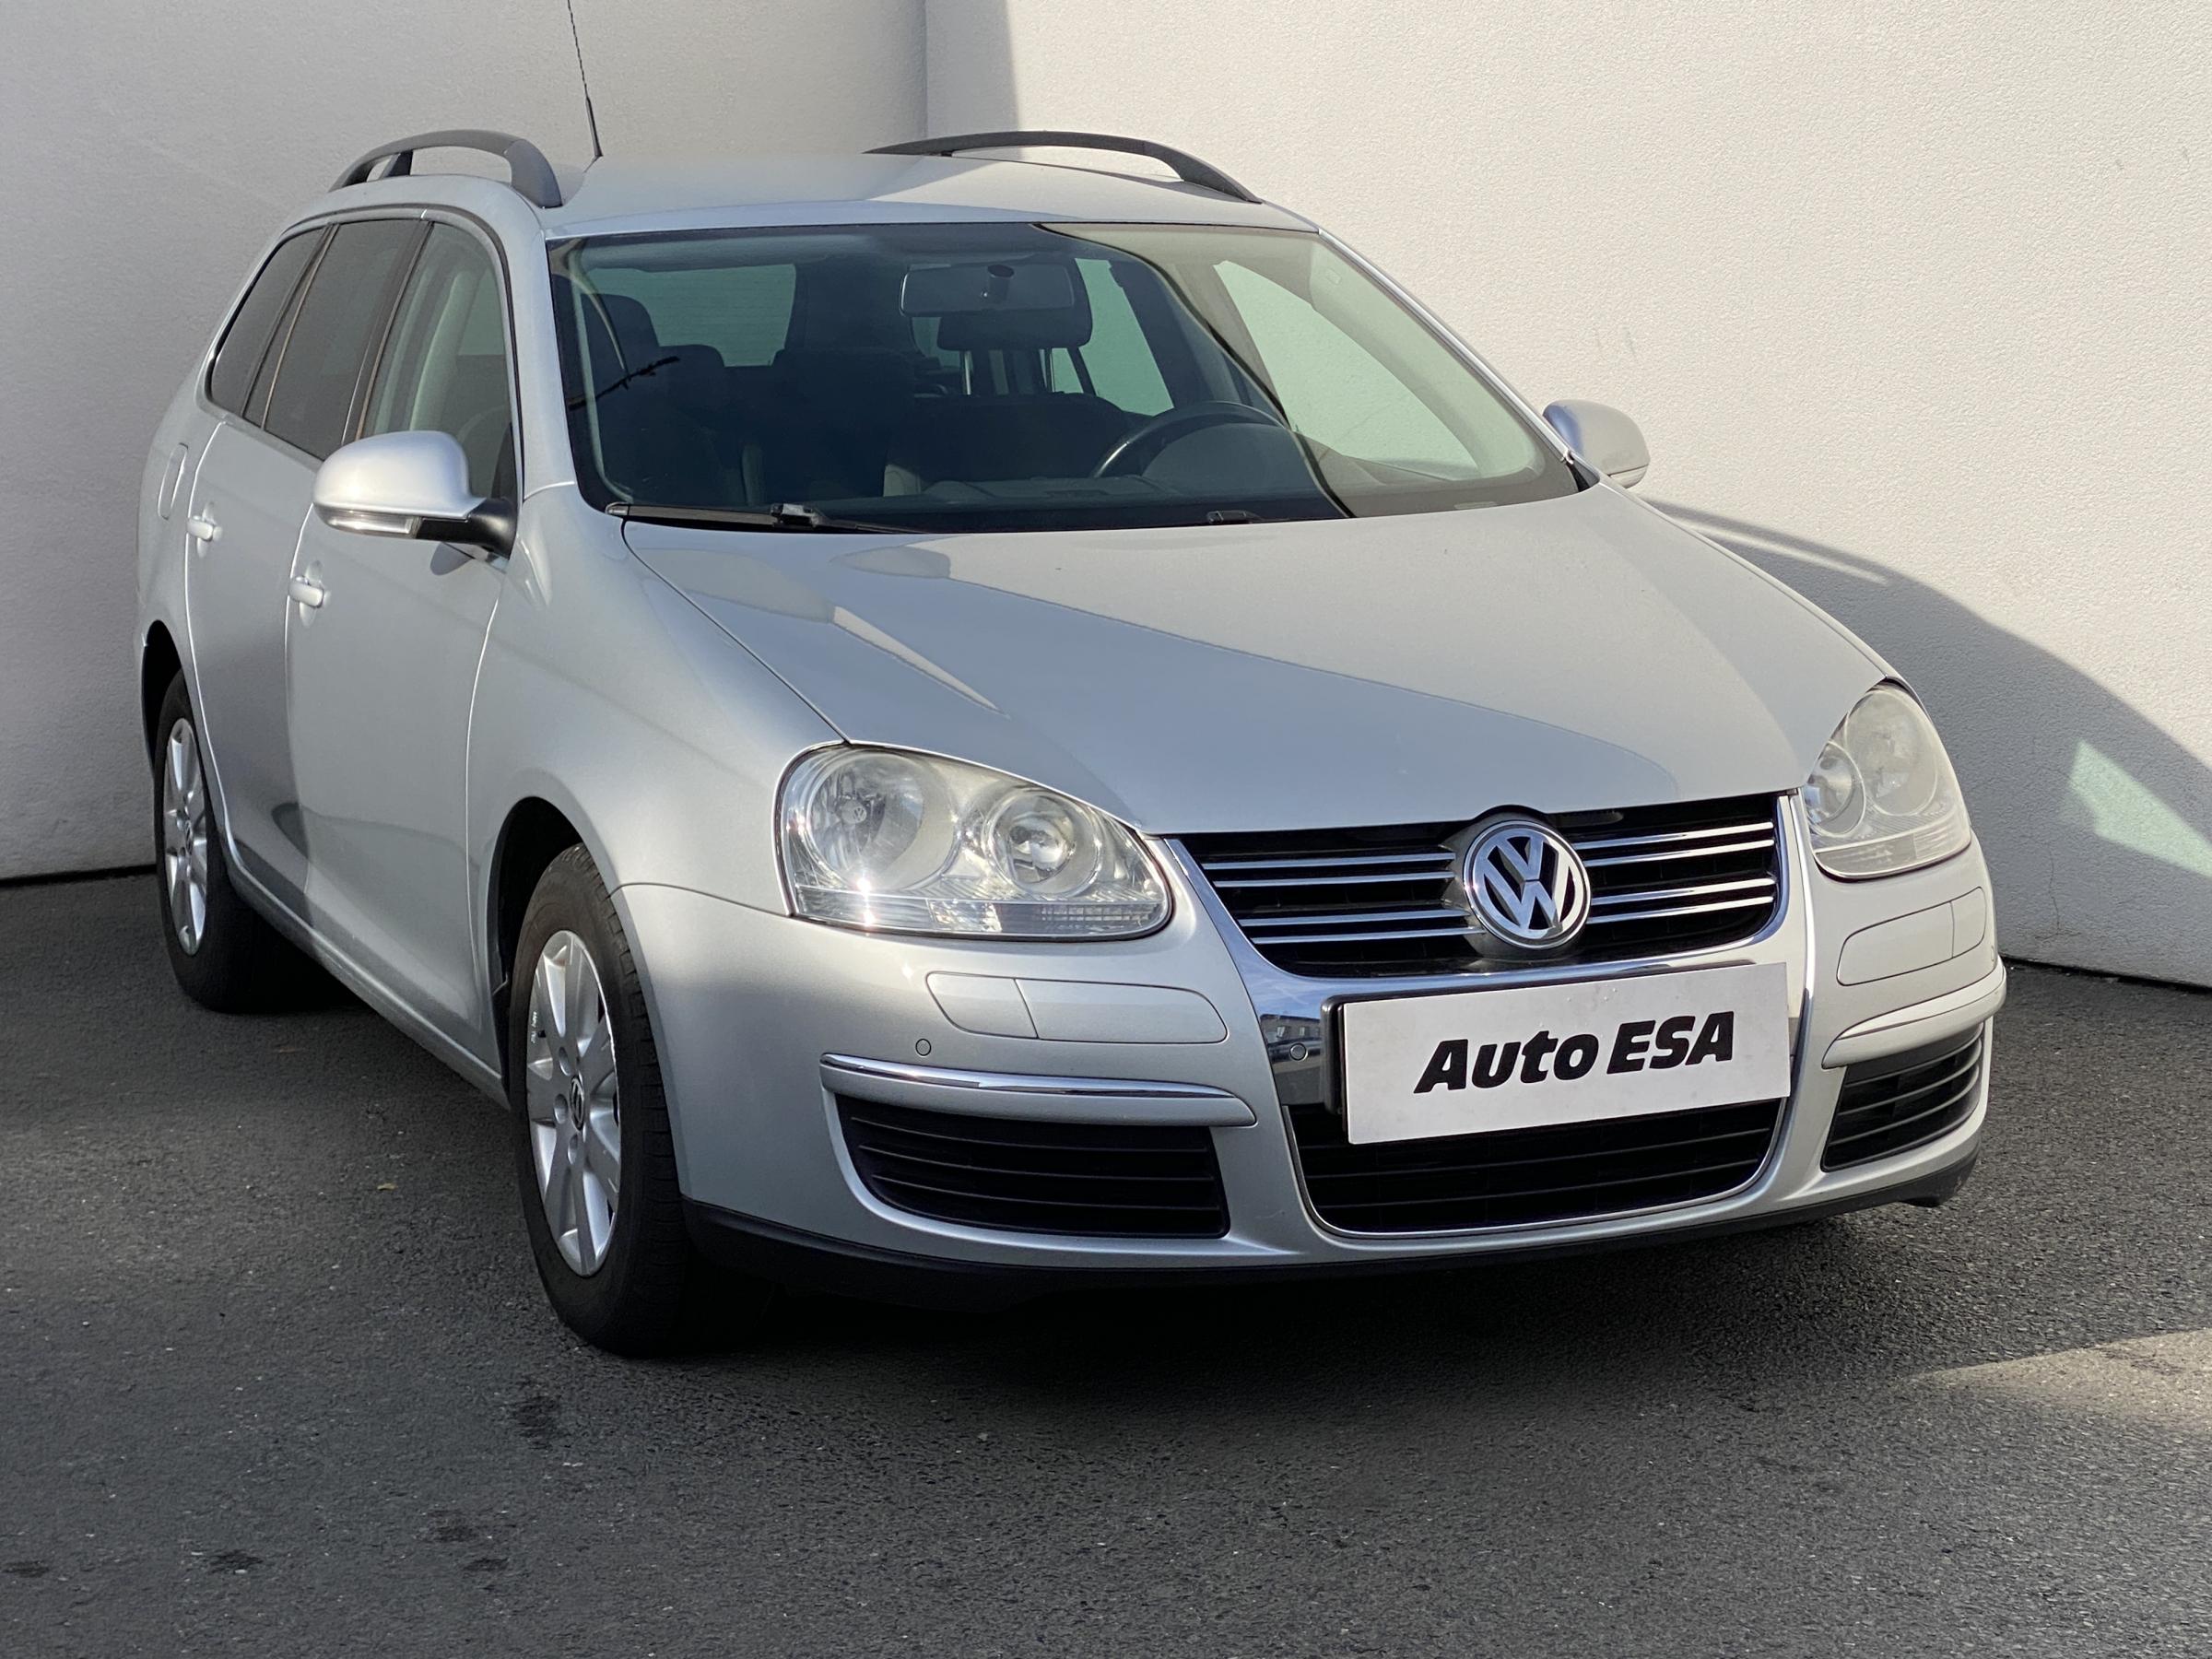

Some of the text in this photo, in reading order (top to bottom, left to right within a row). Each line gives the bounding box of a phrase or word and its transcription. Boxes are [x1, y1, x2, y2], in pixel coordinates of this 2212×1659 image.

[1470, 826, 1585, 941] VW
[1413, 1010, 1735, 1094] Auto ESA
